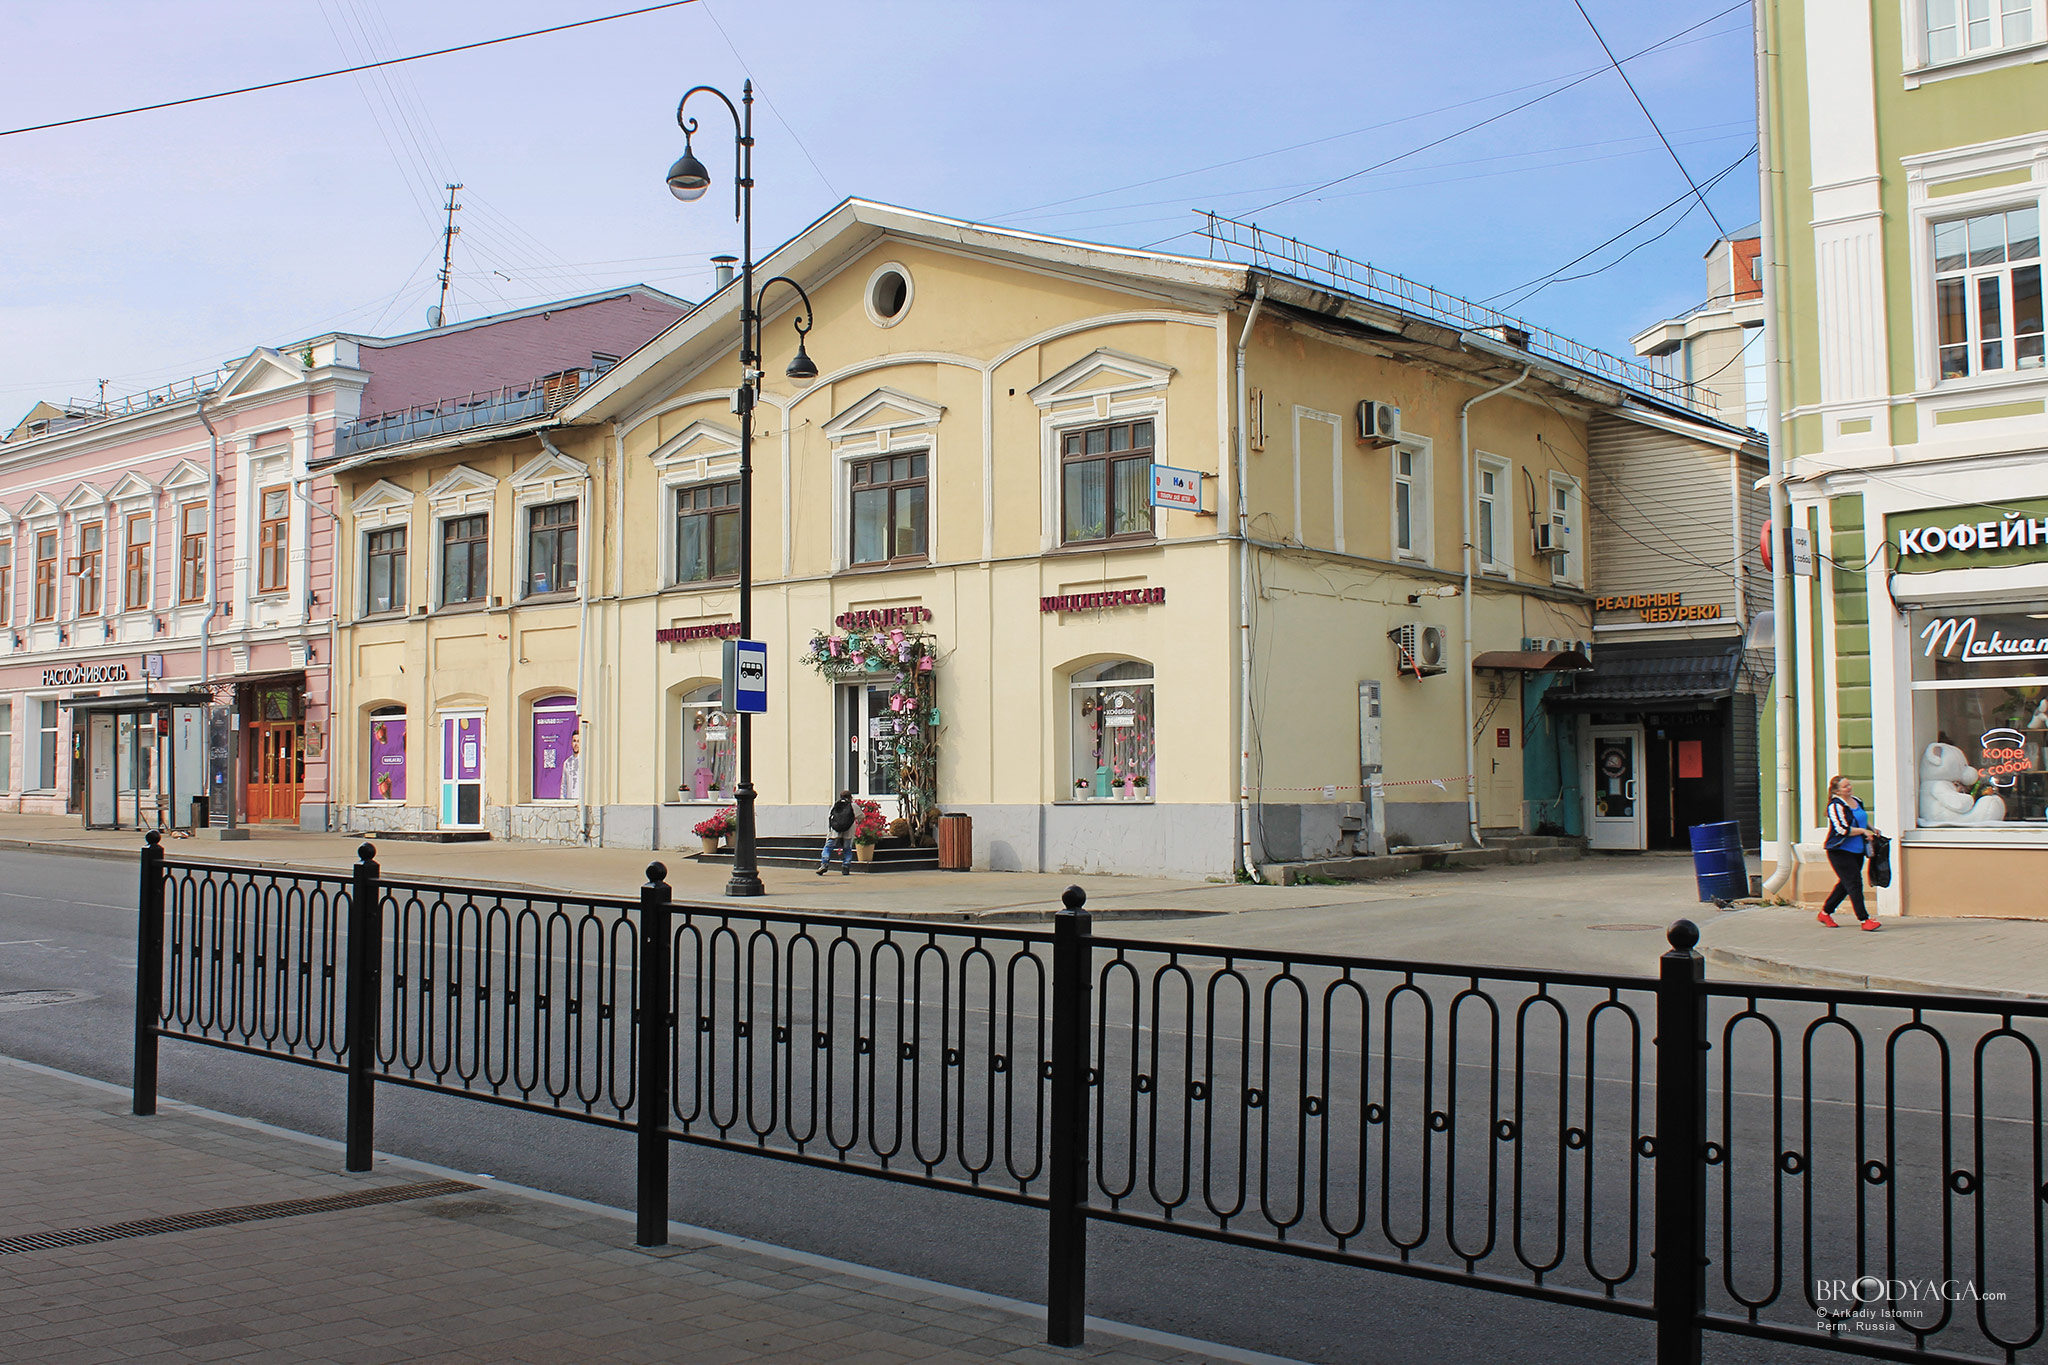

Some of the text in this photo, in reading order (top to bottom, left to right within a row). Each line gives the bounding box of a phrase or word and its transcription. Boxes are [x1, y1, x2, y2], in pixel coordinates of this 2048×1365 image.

[1899, 512, 2048, 555] КОФЕЙН
[1040, 587, 1165, 612] КОНДИТЕРСКАЯ
[1596, 592, 1680, 610] РЕАЛЬНЫЕ
[1640, 604, 1721, 623] ЧЕБУРЕКИ
[42, 663, 128, 686] НАСТОЙЧИВОСТЬ
[1982, 748, 2024, 760] кофе
[1978, 757, 2032, 777] с собой
